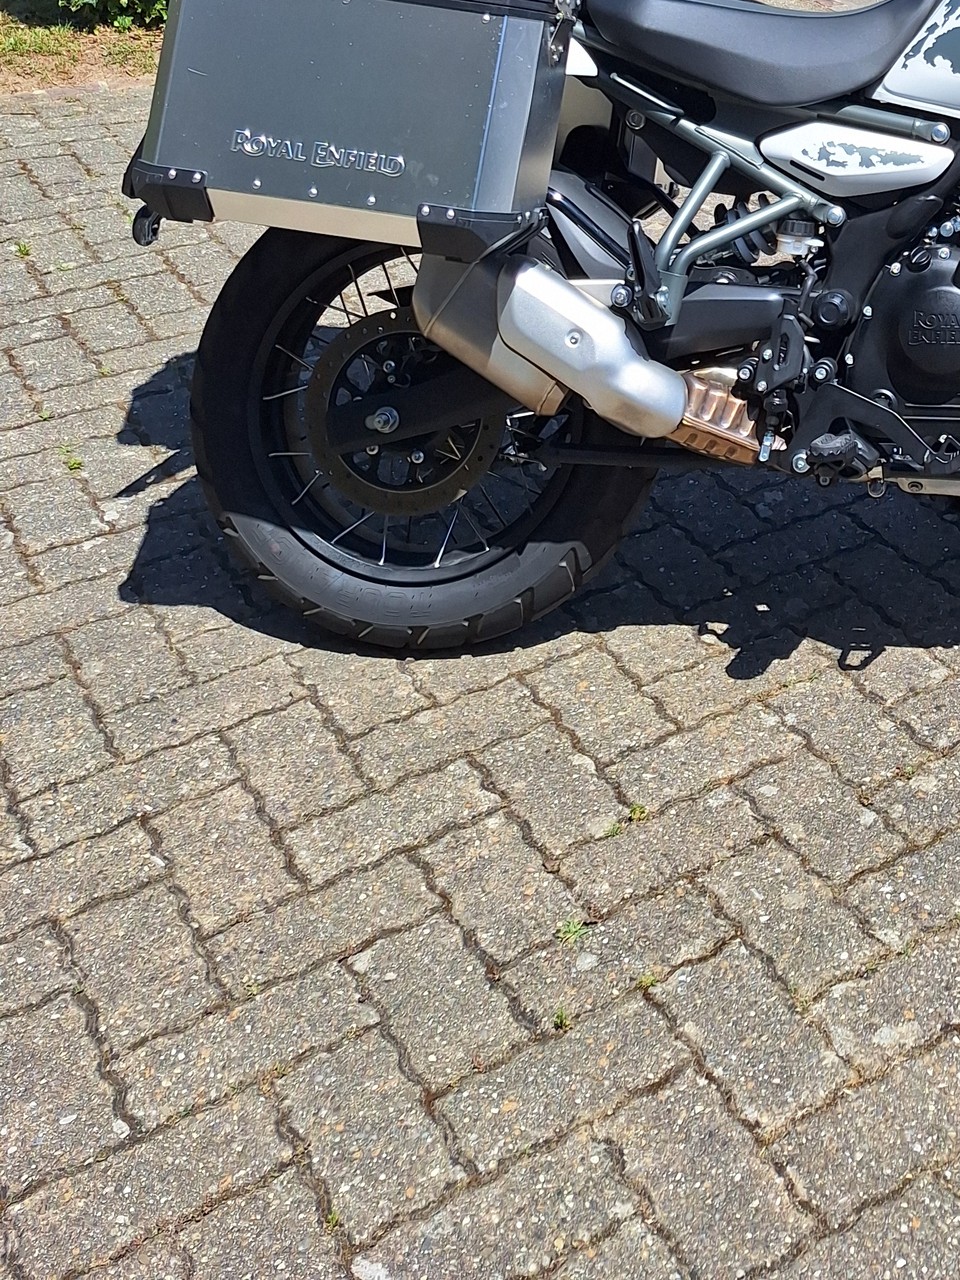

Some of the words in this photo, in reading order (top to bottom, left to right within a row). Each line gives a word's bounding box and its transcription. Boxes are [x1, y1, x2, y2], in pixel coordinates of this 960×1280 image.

[230, 128, 307, 161] ROYAL
[310, 141, 406, 177] ENFIELD
[247, 526, 432, 619] TOURACE
